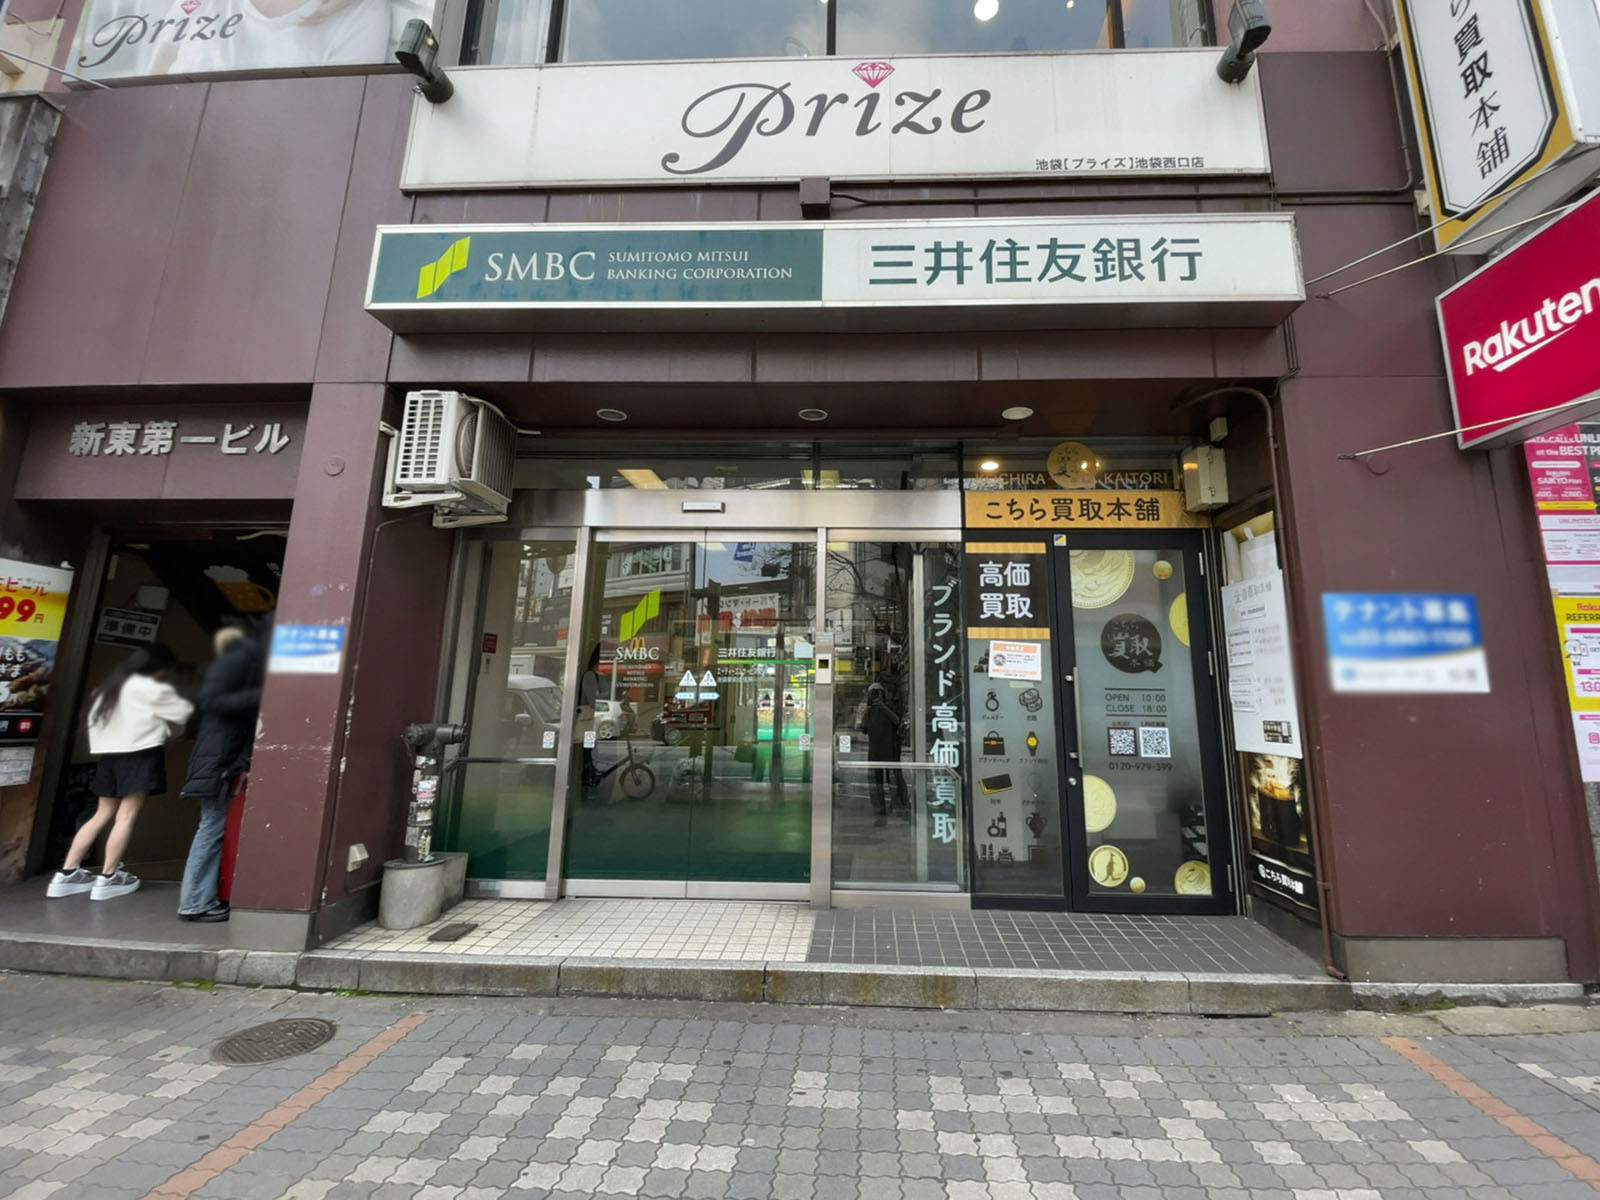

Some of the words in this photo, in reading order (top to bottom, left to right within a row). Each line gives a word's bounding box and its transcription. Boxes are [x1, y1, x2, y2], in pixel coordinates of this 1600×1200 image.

[78, 13, 243, 68] Prize
[661, 81, 991, 175] Prize
[484, 250, 597, 282] SMBC
[607, 250, 693, 263] SUMITOMO
[697, 250, 750, 262] MITSUI
[606, 267, 678, 281] BANKING
[683, 266, 793, 281] CORPORATION
[868, 237, 1203, 287] 三井住友銀行
[1463, 277, 1600, 377] Rakuten
[68, 420, 291, 457] 新東第一ビル
[1559, 446, 1588, 455] BEST
[1104, 472, 1168, 485] KAITORI
[985, 497, 1160, 521] こちら買取本舗
[979, 561, 1031, 587] 高価
[980, 593, 1033, 619] 買取
[615, 646, 660, 661] SMBC
[718, 648, 776, 658] 三井住友銀行
[1105, 693, 1130, 702] OPEN
[1105, 704, 1135, 713] CLOSE
[929, 579, 961, 844] ブランド高価買取
